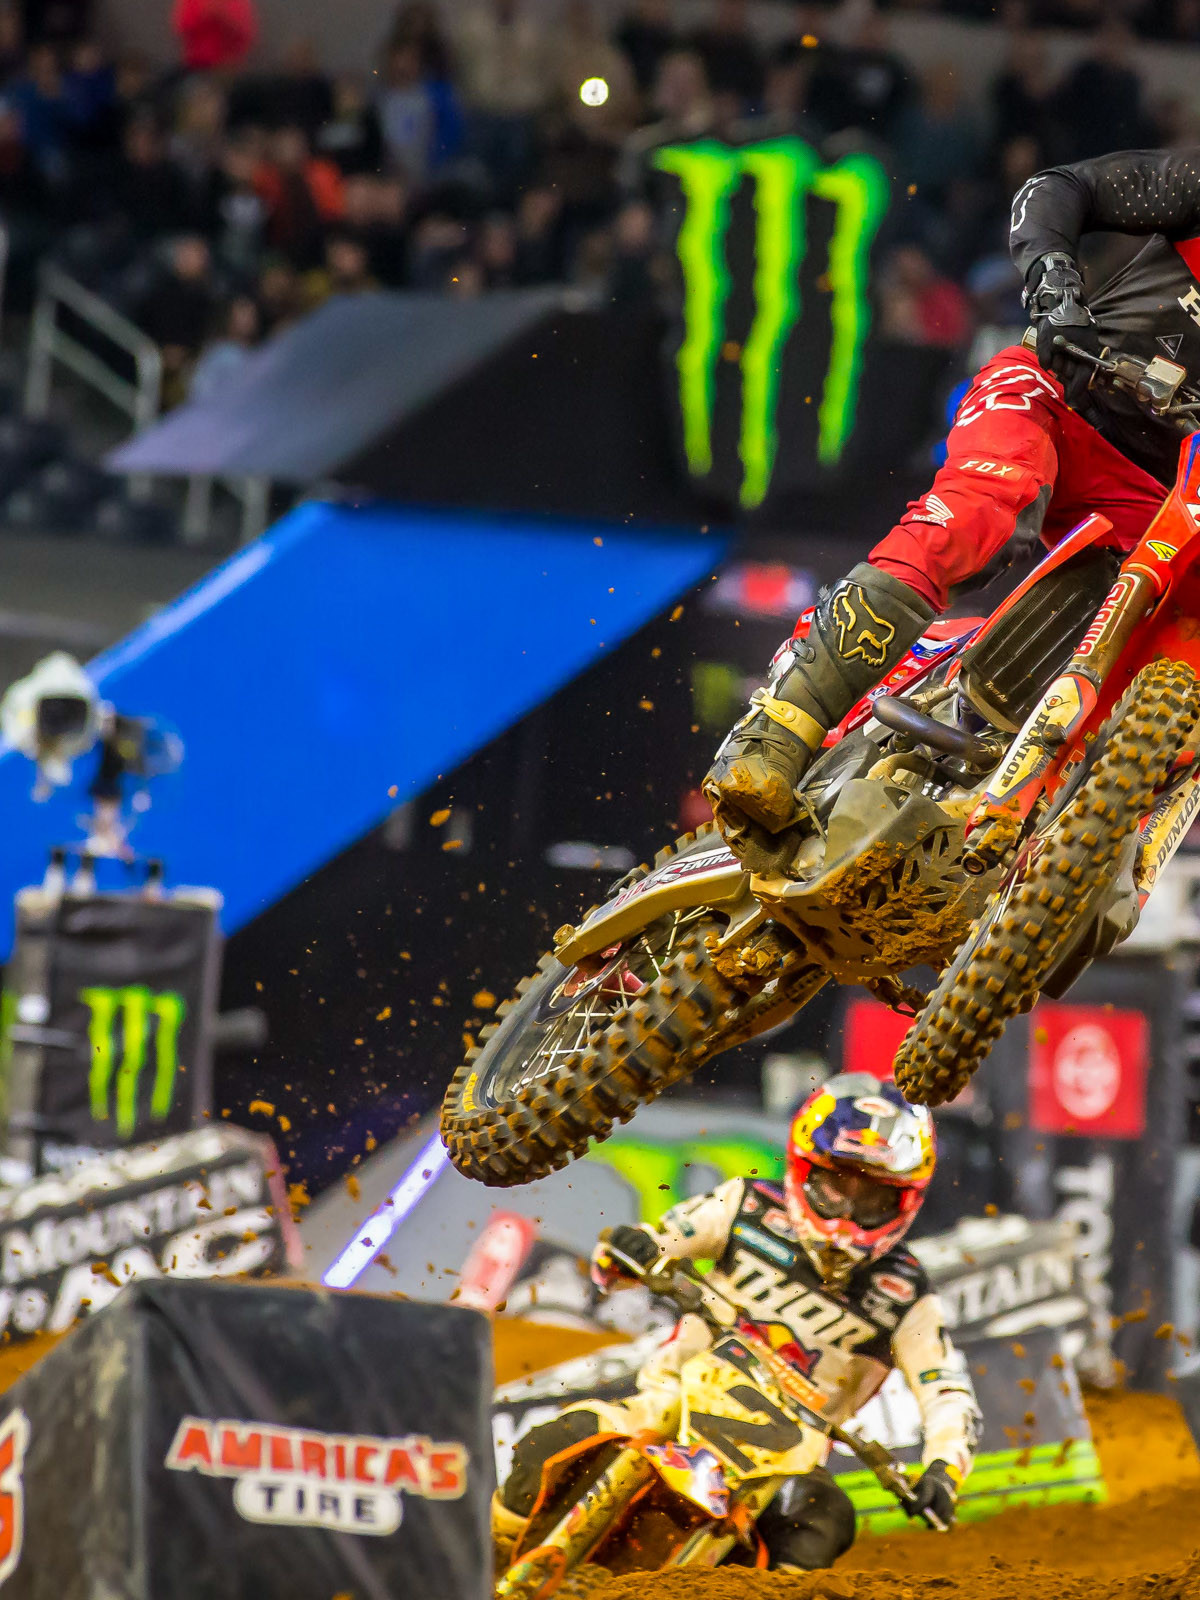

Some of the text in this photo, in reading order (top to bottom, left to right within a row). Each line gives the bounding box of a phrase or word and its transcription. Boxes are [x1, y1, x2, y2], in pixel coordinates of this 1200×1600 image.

[959, 460, 1014, 477] FOX
[1000, 712, 1050, 788] DUNLOP
[1157, 784, 1200, 868] DUNLOP
[727, 1249, 878, 1353] THOR
[171, 1422, 464, 1494] AMERICA'S
[258, 1483, 376, 1524] TIRE
